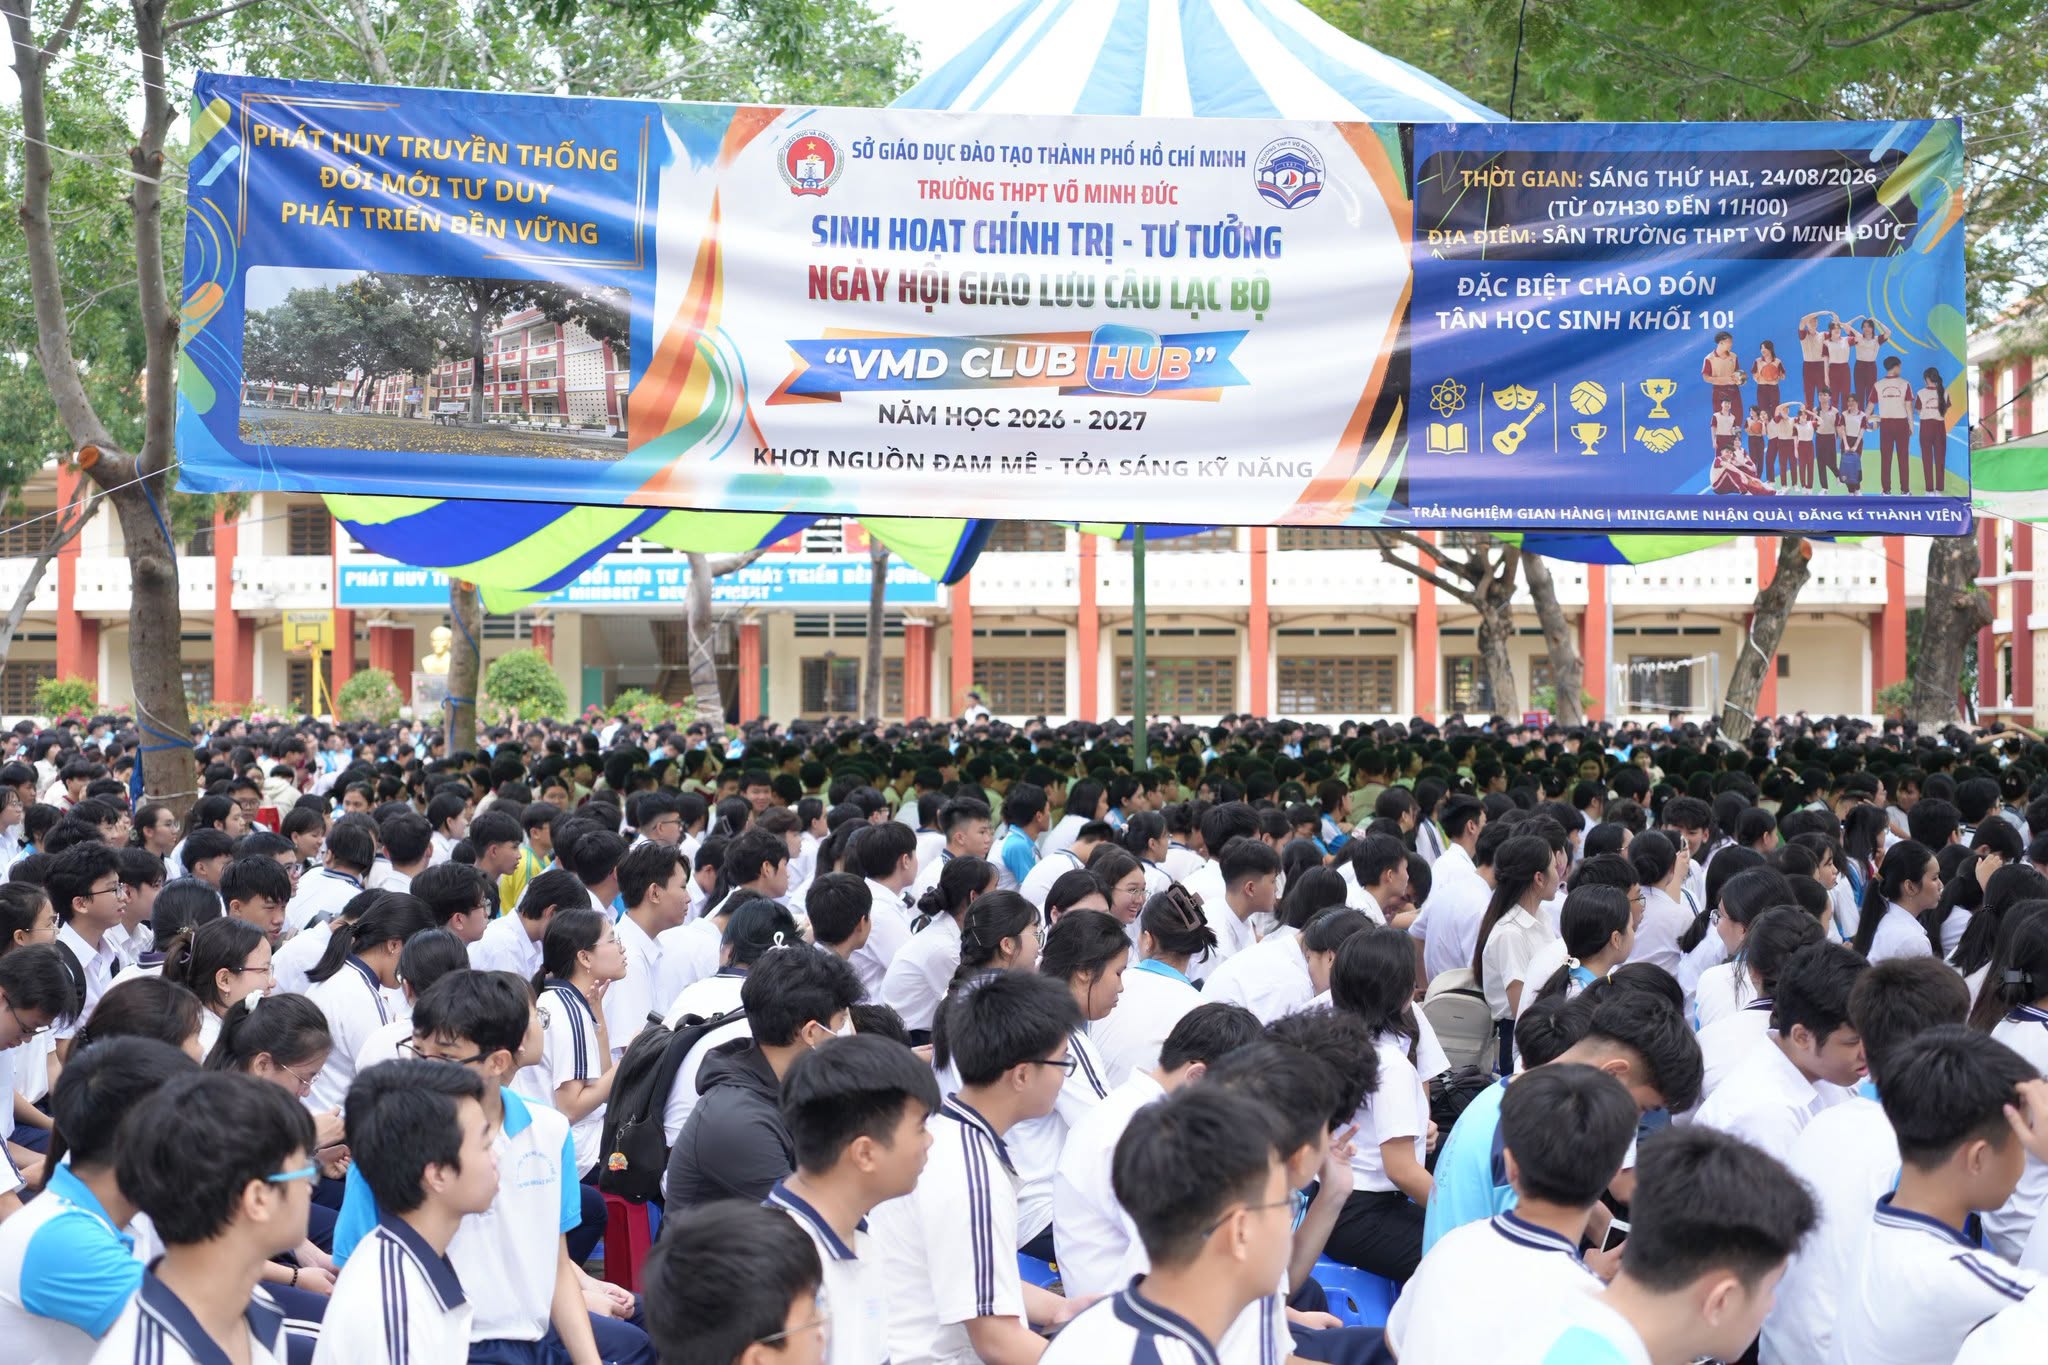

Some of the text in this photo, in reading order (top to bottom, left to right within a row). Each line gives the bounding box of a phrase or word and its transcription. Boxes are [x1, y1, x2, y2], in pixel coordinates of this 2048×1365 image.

[253, 124, 618, 171] PHÁT HUY TRUYỀN THỐNG
[852, 136, 1246, 168] SỞ GIÁO DỤC ĐÀO TẠO THÀNH PHỐ HỒ CHÍ MINH
[320, 163, 555, 204] ĐỔI MỚI TƯ DUY
[917, 175, 1178, 205] TRƯỜNG THPT VÕ MINH ĐỨC
[1460, 166, 1877, 189] THỜI GIAN: SÁNG THỨ HAI, 24/08/2026
[282, 200, 598, 245] PHÁT TRIỂN BỀN VỮNG
[1548, 194, 1788, 221] (TỪ 07H30 ĐẾN 11H00)
[812, 214, 880, 249] SINH
[889, 218, 966, 260] HOẠT
[973, 210, 1059, 256] CHÍNH
[1068, 222, 1113, 264] TRỊ
[1141, 220, 1180, 258] TƯ
[1185, 213, 1282, 259] TƯỞNG
[1427, 222, 1906, 246] ĐỊA ĐIỂM: SÂN TRƯỜNG THPT VÕ MINH ĐỨC
[809, 258, 1270, 320] NGÀY HỘI GIAO LƯU CÂU LẠC BỘ
[1457, 270, 1716, 302] ĐẶC BIỆT CHÀO ĐÓN
[1436, 304, 1735, 335] TÂN HỌC SINH KHỐI 10!
[960, 346, 1077, 378] CLUB
[878, 399, 937, 425] NĂM
[945, 406, 1000, 432] HỌC
[1008, 408, 1066, 429] 2026
[1088, 410, 1147, 431] 2027
[755, 447, 819, 468] KHƠI
[828, 446, 925, 470] NGUỒN
[932, 454, 991, 473] ĐAM
[1001, 451, 1037, 475] MÊ
[1060, 451, 1112, 476] TỎA
[1120, 454, 1188, 477] SÁNG
[1198, 457, 1229, 477] KỸ
[1238, 457, 1313, 478] NĂNG
[1412, 503, 1447, 519] TRẢI
[1451, 505, 1513, 522] NGHIỆM
[1517, 507, 1556, 520] GIAN
[1617, 507, 1698, 521] MINIGAME
[1702, 508, 1749, 523] NHẬN
[1799, 509, 1843, 522] ĐĂNG
[1848, 508, 1864, 522] KÍ
[1867, 508, 1922, 522] THÀNH
[1927, 509, 1962, 523] VIÊN
